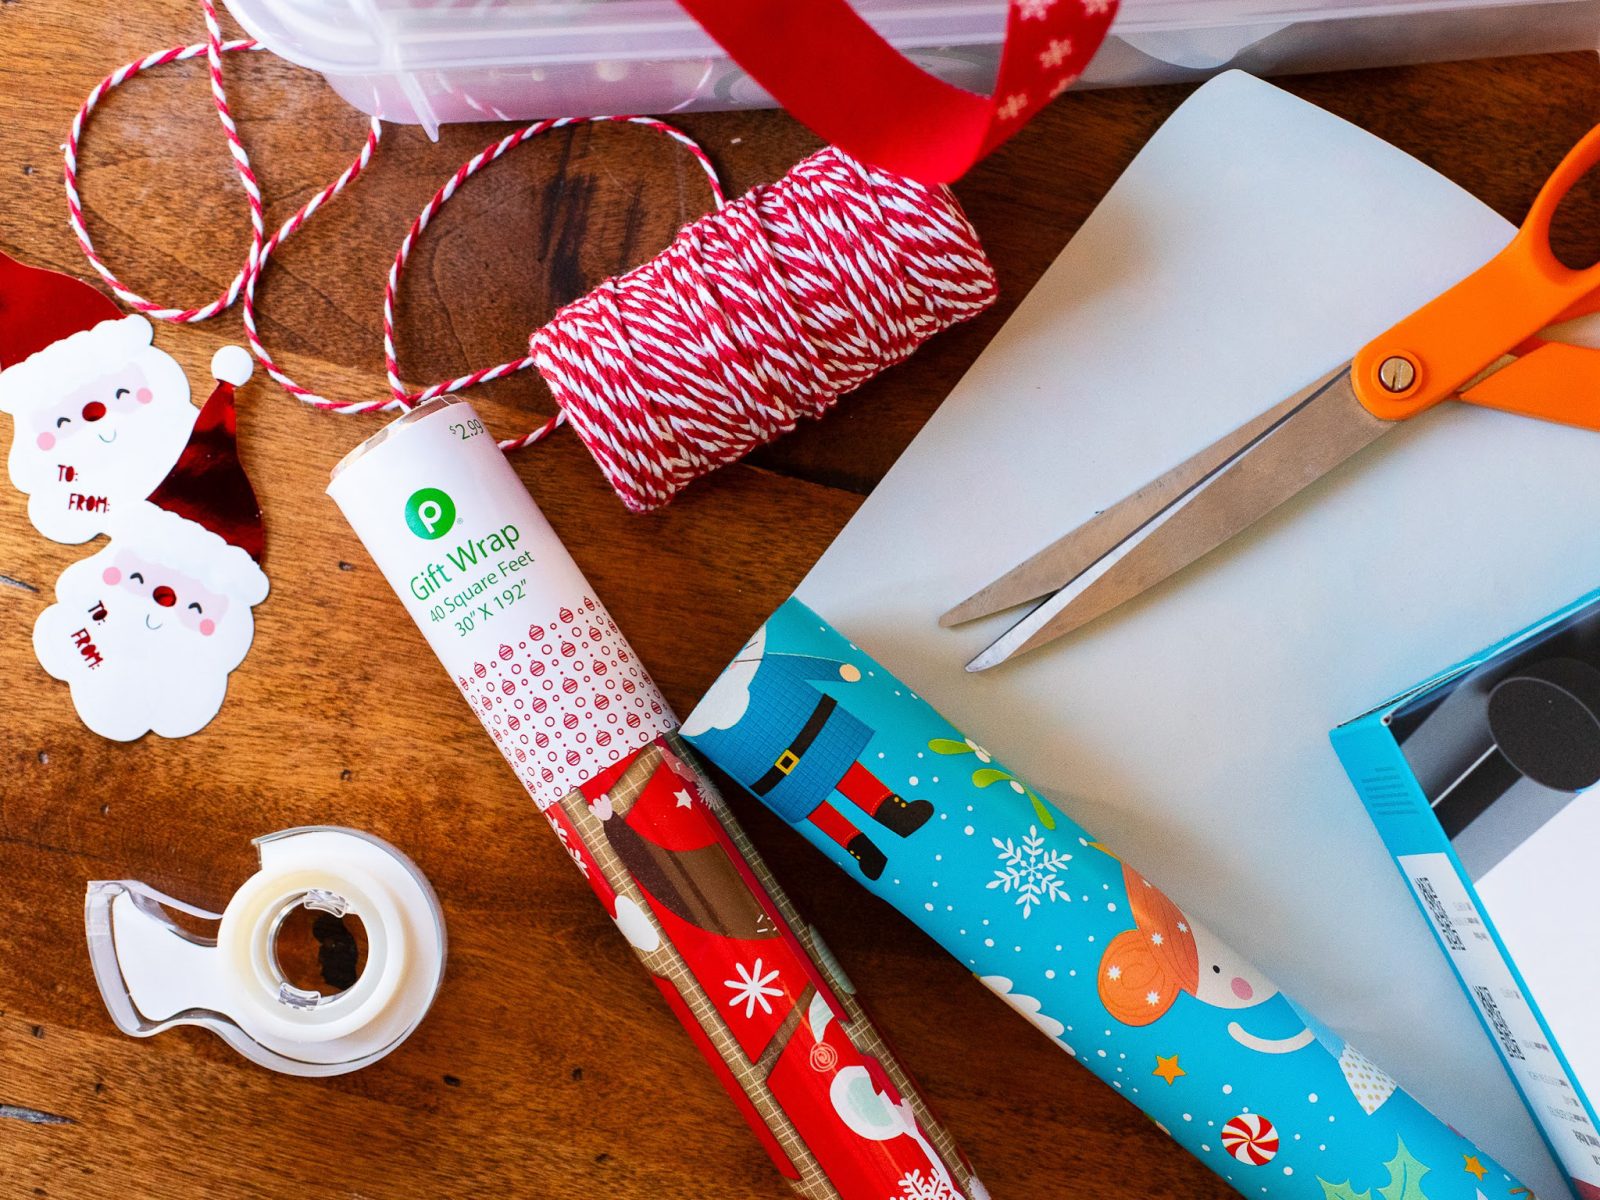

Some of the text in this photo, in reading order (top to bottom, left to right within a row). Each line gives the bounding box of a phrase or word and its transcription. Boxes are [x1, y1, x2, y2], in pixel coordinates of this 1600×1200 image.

[449, 419, 484, 440] $2.99
[57, 464, 79, 482] TO:
[68, 493, 111, 513] FROM:
[410, 523, 520, 601] Gift Wrap
[430, 550, 535, 623] 40 Square Feet
